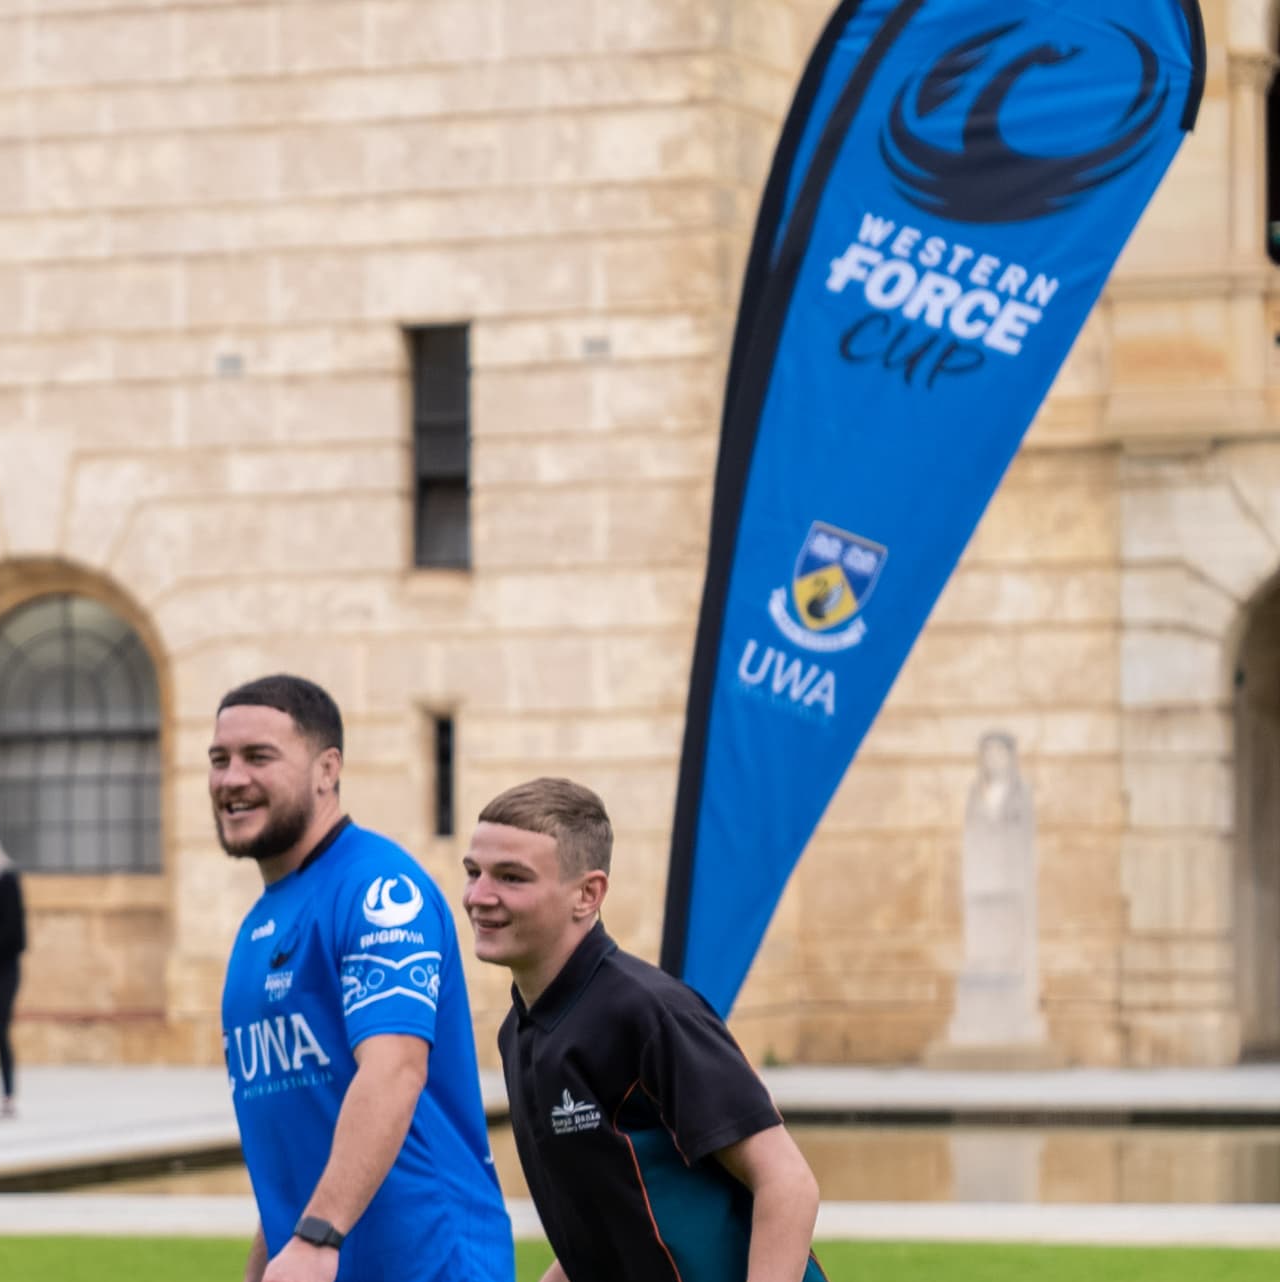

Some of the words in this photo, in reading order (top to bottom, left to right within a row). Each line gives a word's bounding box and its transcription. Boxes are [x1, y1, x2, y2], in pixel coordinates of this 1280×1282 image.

[858, 212, 1059, 307] WESTERN
[826, 242, 1042, 356] FORCE
[839, 313, 986, 390] CUP
[738, 639, 836, 715] UWA
[235, 1013, 331, 1082] UWA
